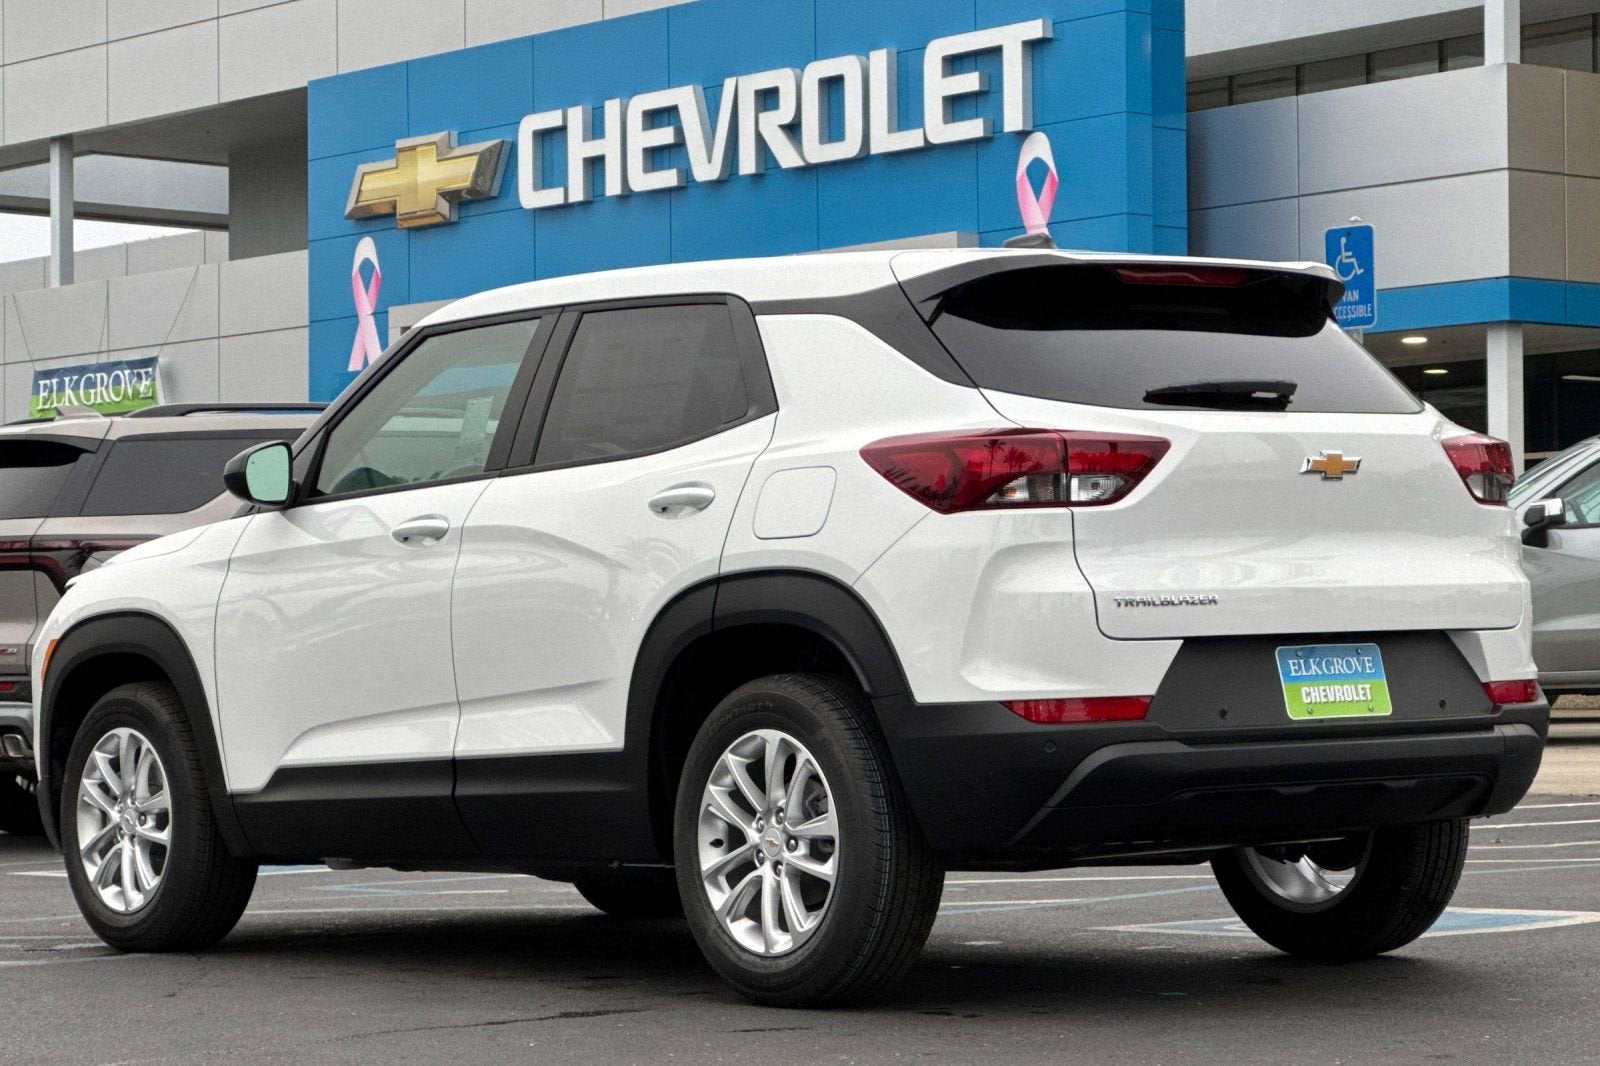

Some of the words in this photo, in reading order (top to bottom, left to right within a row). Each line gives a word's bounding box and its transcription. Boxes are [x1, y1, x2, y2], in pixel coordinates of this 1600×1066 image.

[518, 18, 1053, 210] CHEVROLET
[1333, 304, 1373, 319] CCESSIBLE
[1113, 595, 1218, 608] TRAILBLAZER
[1301, 684, 1372, 704] CHEVROLET
